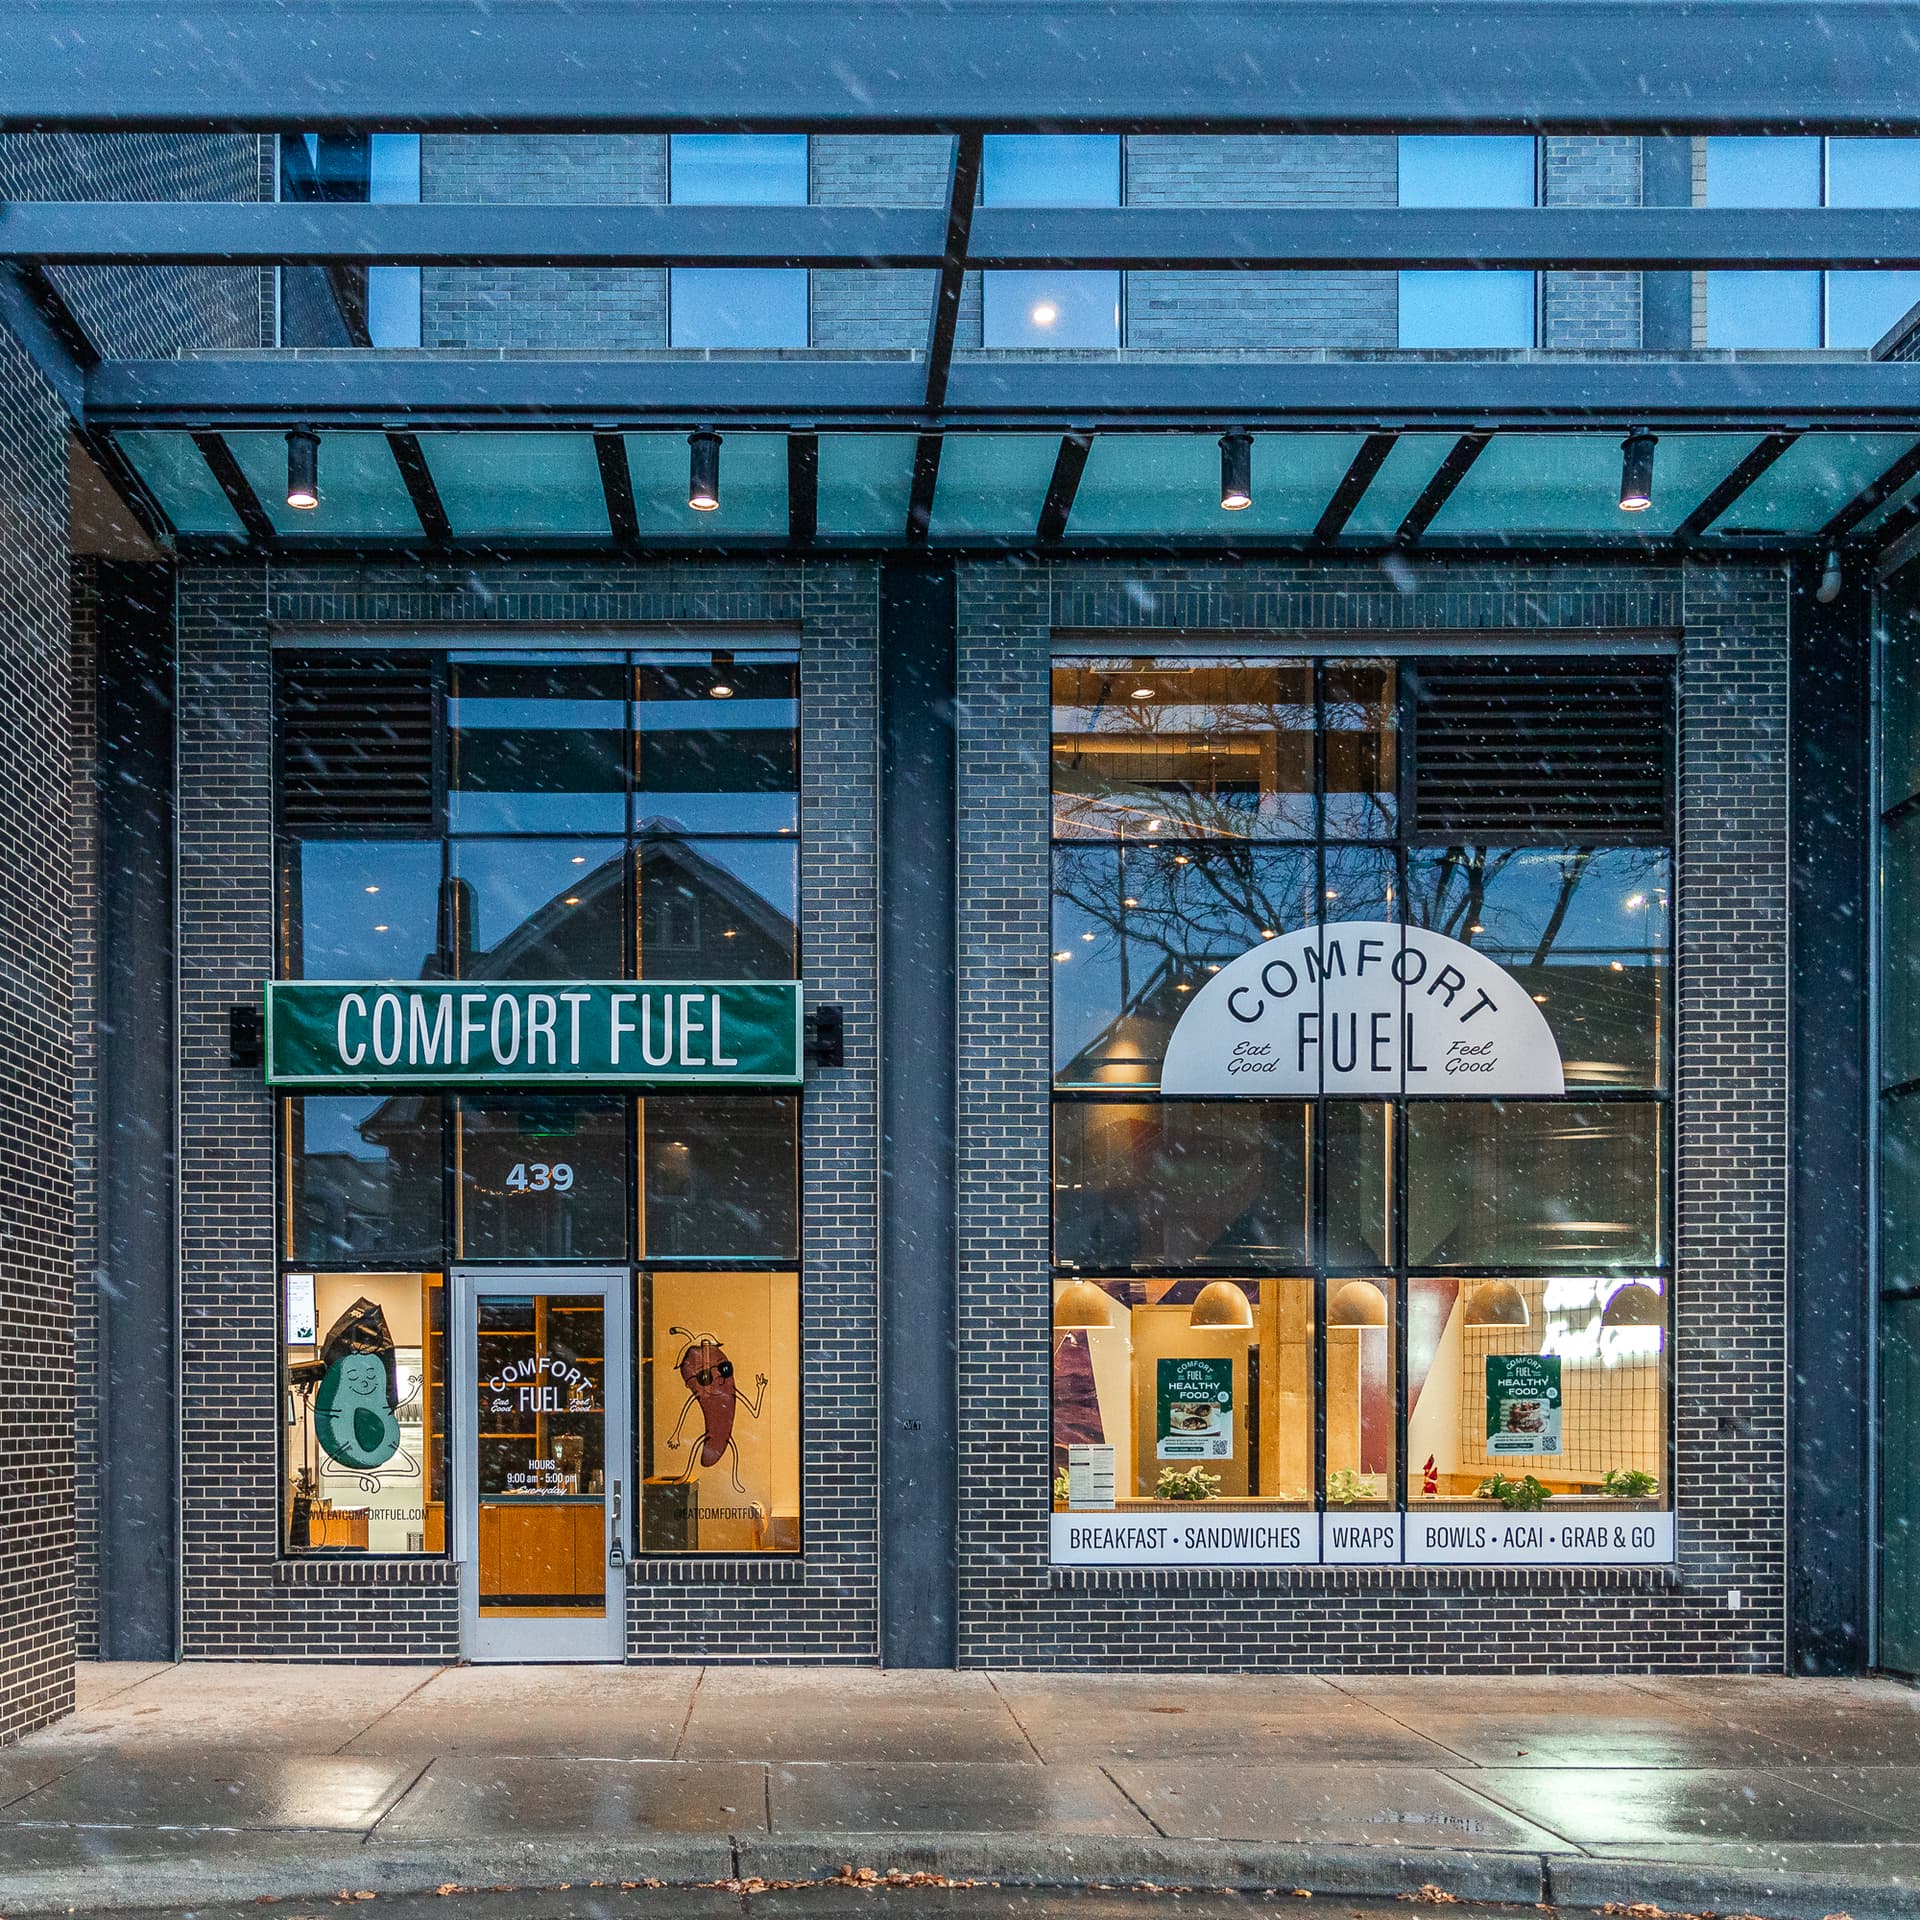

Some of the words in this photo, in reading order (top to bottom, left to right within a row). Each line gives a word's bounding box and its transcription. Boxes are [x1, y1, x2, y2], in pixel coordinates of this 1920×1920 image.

[1228, 939, 1498, 1024] COMFORT
[337, 992, 592, 1066] COMFORT
[611, 993, 738, 1066] FUEL
[1232, 1041, 1271, 1056] Eat
[1298, 1012, 1427, 1073] FUEL
[1445, 1041, 1494, 1056] Feel
[1227, 1058, 1280, 1075] Good
[1445, 1058, 1496, 1075] Good
[506, 1163, 574, 1191] 439
[1177, 1360, 1214, 1374] COMFORT
[1506, 1357, 1542, 1370] COMFORT
[489, 1358, 592, 1393] COMFORT
[1187, 1370, 1202, 1381] FUEL
[1516, 1367, 1531, 1377] FUEL
[1168, 1382, 1221, 1390] HEALTHY
[1497, 1379, 1548, 1387] HEALTHY
[519, 1386, 563, 1412] FUEL
[1180, 1391, 1209, 1399] FOOD
[1508, 1387, 1538, 1396] FOOD
[528, 1459, 555, 1470] HOURS
[507, 1473, 526, 1483] 9:00
[526, 1475, 538, 1483] am
[545, 1473, 563, 1483] 5:00
[565, 1474, 577, 1485] pm
[519, 1485, 568, 1496] Everyday
[302, 1509, 430, 1520] WW.EATCOMFORTFUEL.COM
[1070, 1528, 1167, 1549] BREAKFAST
[1185, 1527, 1300, 1549] SANDWICHES
[1333, 1527, 1394, 1549] WRAPS
[1426, 1527, 1485, 1548] BOWLS
[1503, 1527, 1543, 1548] ACAI
[1561, 1527, 1608, 1548] GRAB
[1613, 1527, 1626, 1548] &
[1631, 1526, 1655, 1548] GO
